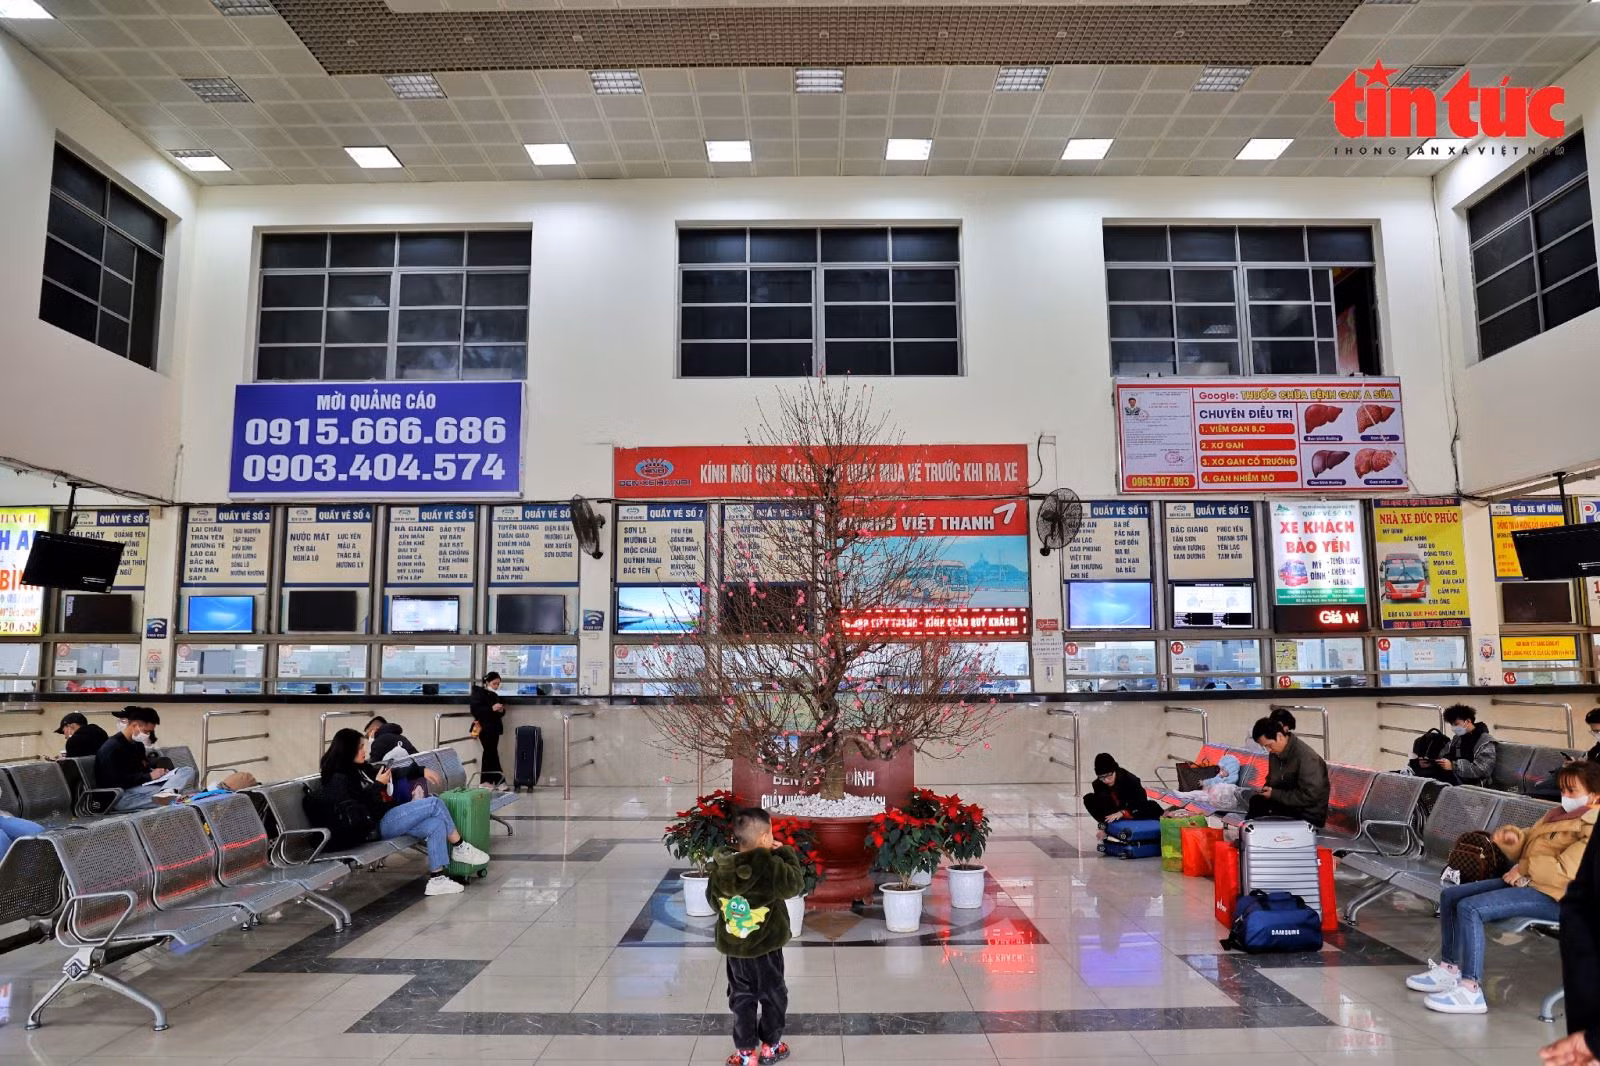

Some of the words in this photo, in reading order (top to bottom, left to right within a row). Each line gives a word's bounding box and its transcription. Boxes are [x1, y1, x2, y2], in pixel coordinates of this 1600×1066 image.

[317, 391, 346, 411] MỜI
[350, 389, 400, 412] QUẢNG
[406, 390, 436, 410] CÁO
[1199, 392, 1239, 401] Google:
[1338, 390, 1362, 400] GAN
[1200, 408, 1245, 419] CHUYÊN
[1249, 405, 1273, 418] ĐIỀU
[1277, 410, 1292, 420] TRỊ
[245, 416, 506, 445] 0915.666.686
[243, 454, 505, 482] 0903.404.574
[700, 460, 727, 483] KÍNH
[880, 464, 905, 482] MUA
[926, 459, 960, 482] TRƯỚC
[964, 463, 982, 482] KHI
[986, 463, 1001, 482] RA
[1004, 463, 1018, 482] XE
[219, 510, 239, 521] QUẦY
[241, 511, 250, 520] VÉ
[253, 510, 264, 520] SỐ
[265, 512, 270, 520] 3
[319, 510, 339, 520] QUẦY
[341, 510, 351, 520] VÉ
[353, 509, 365, 520] SỐ
[422, 509, 442, 520] QUẦY
[444, 511, 454, 519] VÉ
[456, 508, 468, 519] SỐ
[525, 508, 546, 519] QUẦY
[548, 508, 557, 518] VÉ
[560, 507, 571, 518] SỐ
[650, 507, 671, 518] QUẦY
[673, 508, 683, 517] VÉ
[686, 507, 697, 517] SỐ
[1093, 505, 1114, 515] QUẦY
[1116, 506, 1126, 515] VÉ
[1128, 505, 1138, 515] SỐ
[1196, 504, 1216, 515] QUẦY
[1217, 505, 1226, 515] VÉ
[1229, 504, 1239, 515] SỐ
[100, 513, 120, 524] QUẦY
[122, 514, 131, 523] VÉ
[133, 513, 144, 523] SỐ
[1380, 510, 1398, 524] NHÀ
[1401, 513, 1412, 524] XE
[1415, 511, 1432, 523] ĐỨC
[1435, 510, 1458, 523] PHÚC
[902, 513, 936, 534] VIỆT
[940, 516, 994, 530] THANH
[1280, 521, 1298, 534] XE
[1304, 519, 1355, 533] KHÁCH
[290, 531, 311, 541] NƯỚC
[1286, 537, 1317, 553] BẢO
[1323, 536, 1350, 553] YẾN
[1320, 610, 1343, 624] Giá
[1280, 677, 1290, 686] 13
